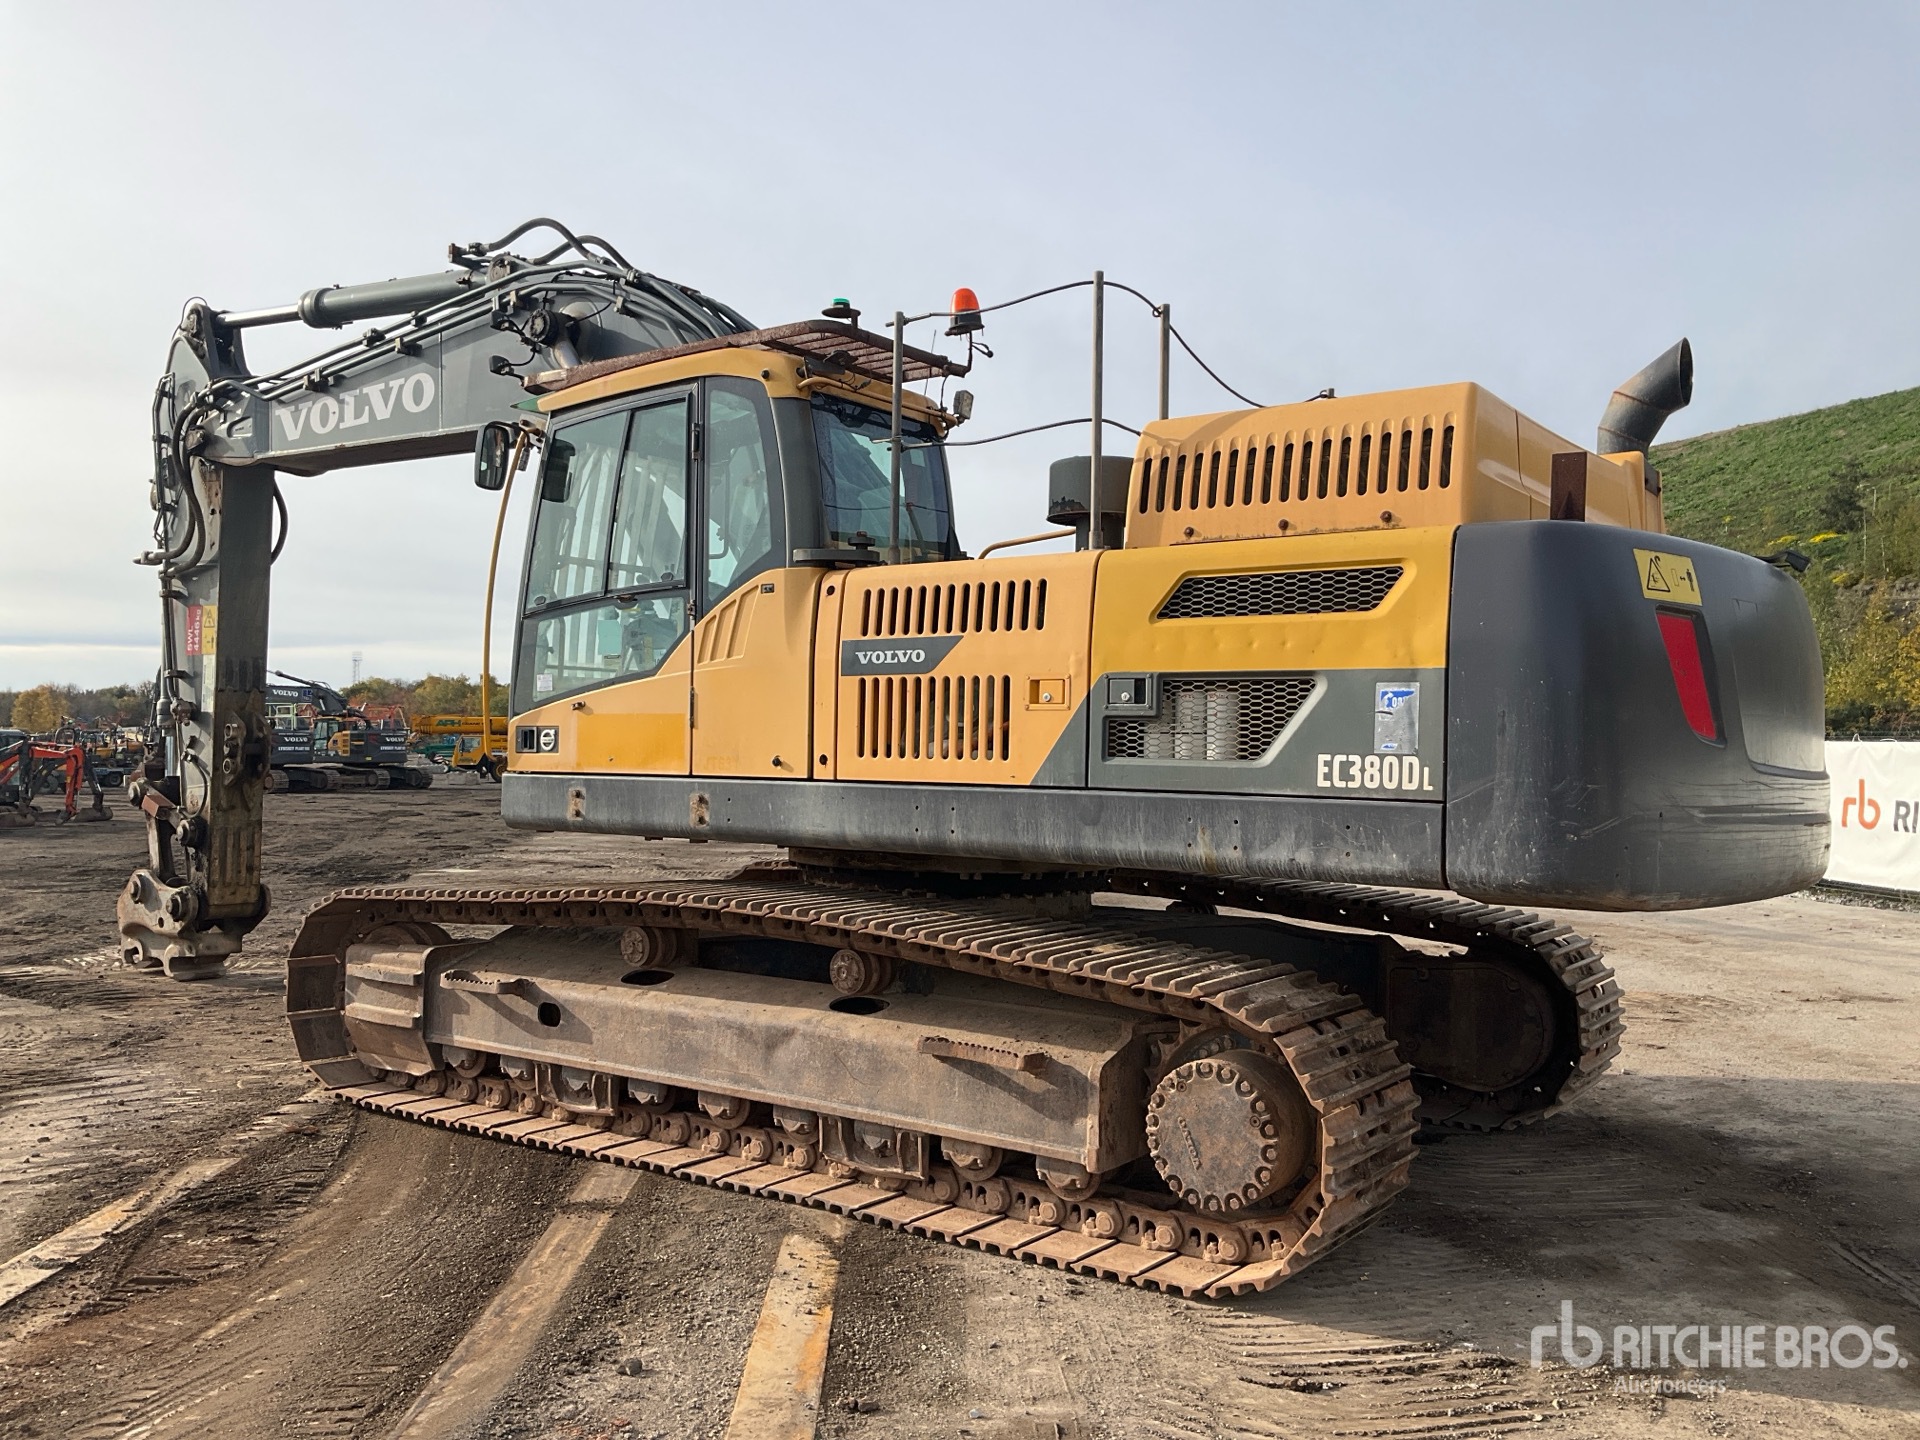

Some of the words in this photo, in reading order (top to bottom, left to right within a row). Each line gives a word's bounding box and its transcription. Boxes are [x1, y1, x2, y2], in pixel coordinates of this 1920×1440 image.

[275, 372, 435, 441] VOLVO
[855, 649, 926, 665] VOLVO
[272, 689, 299, 698] VOLVO
